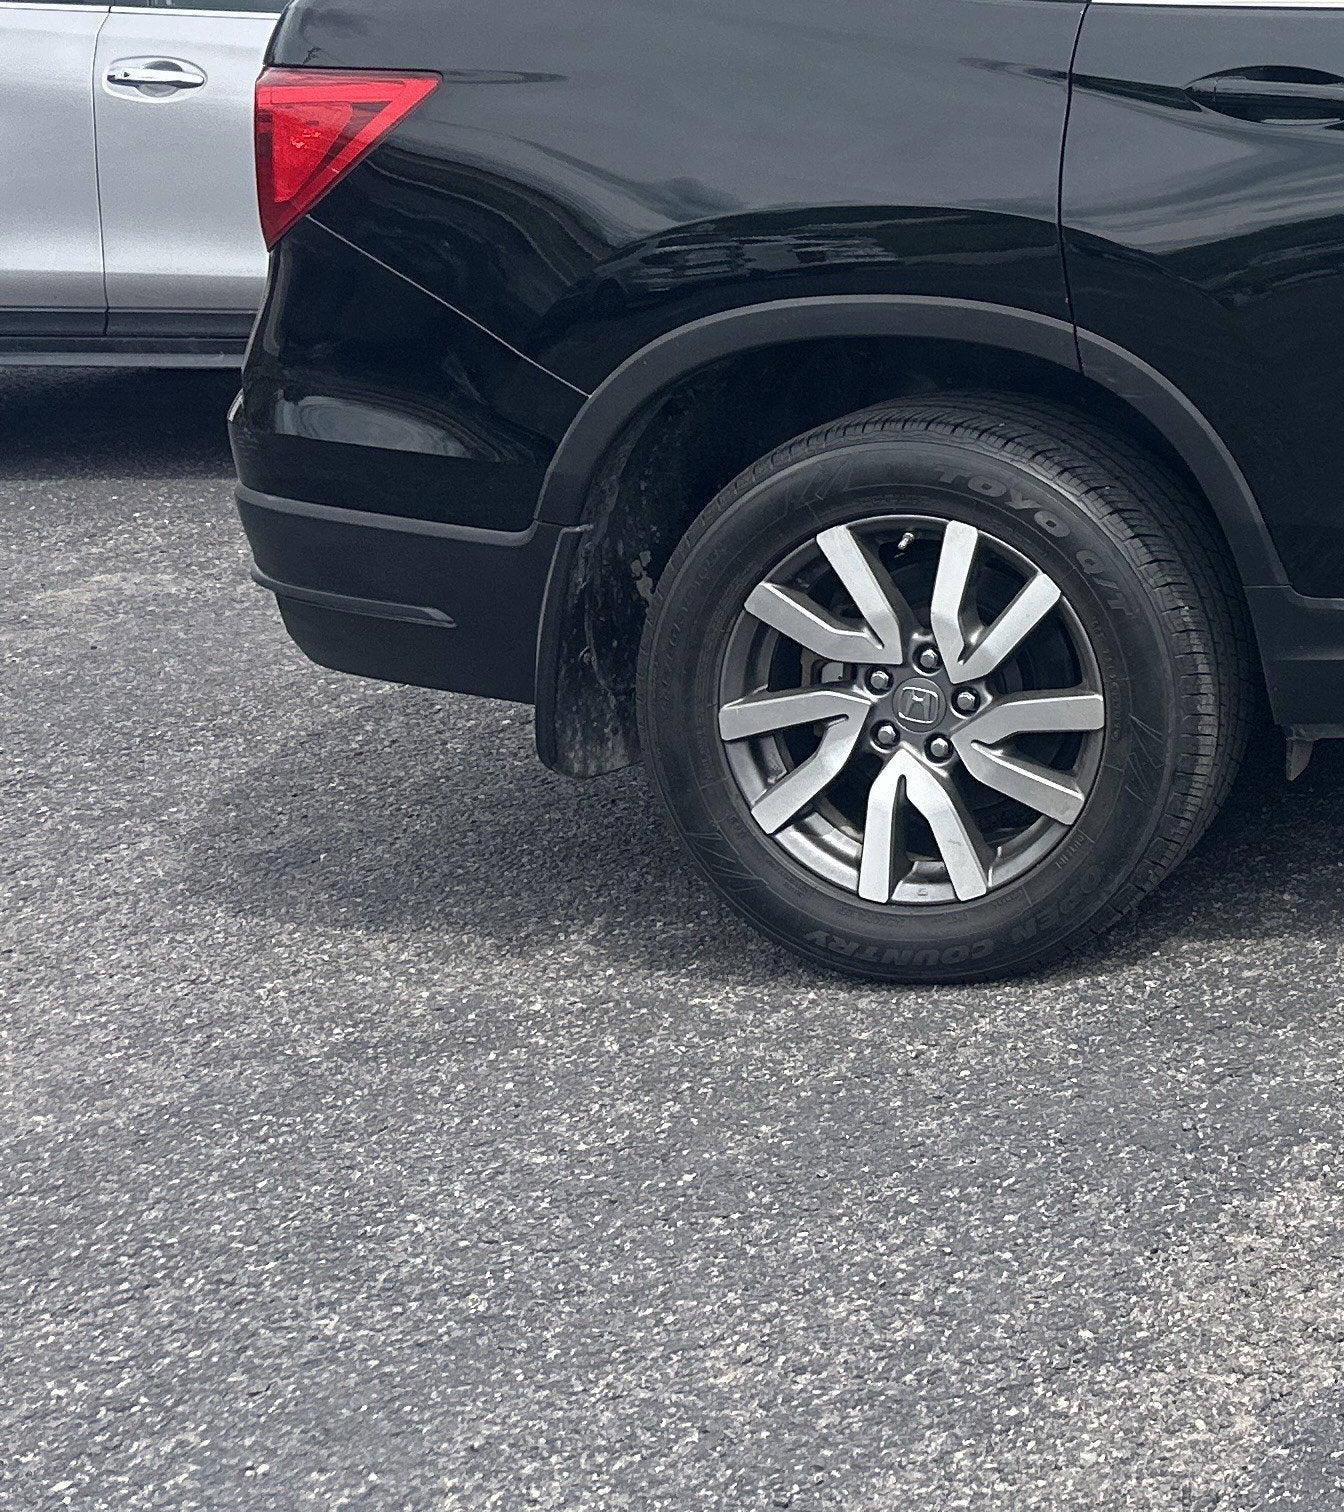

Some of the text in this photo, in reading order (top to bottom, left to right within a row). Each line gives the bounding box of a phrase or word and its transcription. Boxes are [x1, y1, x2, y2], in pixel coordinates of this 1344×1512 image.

[934, 463, 1141, 616] TOYO Q/T
[804, 929, 995, 966] COUNTRY
